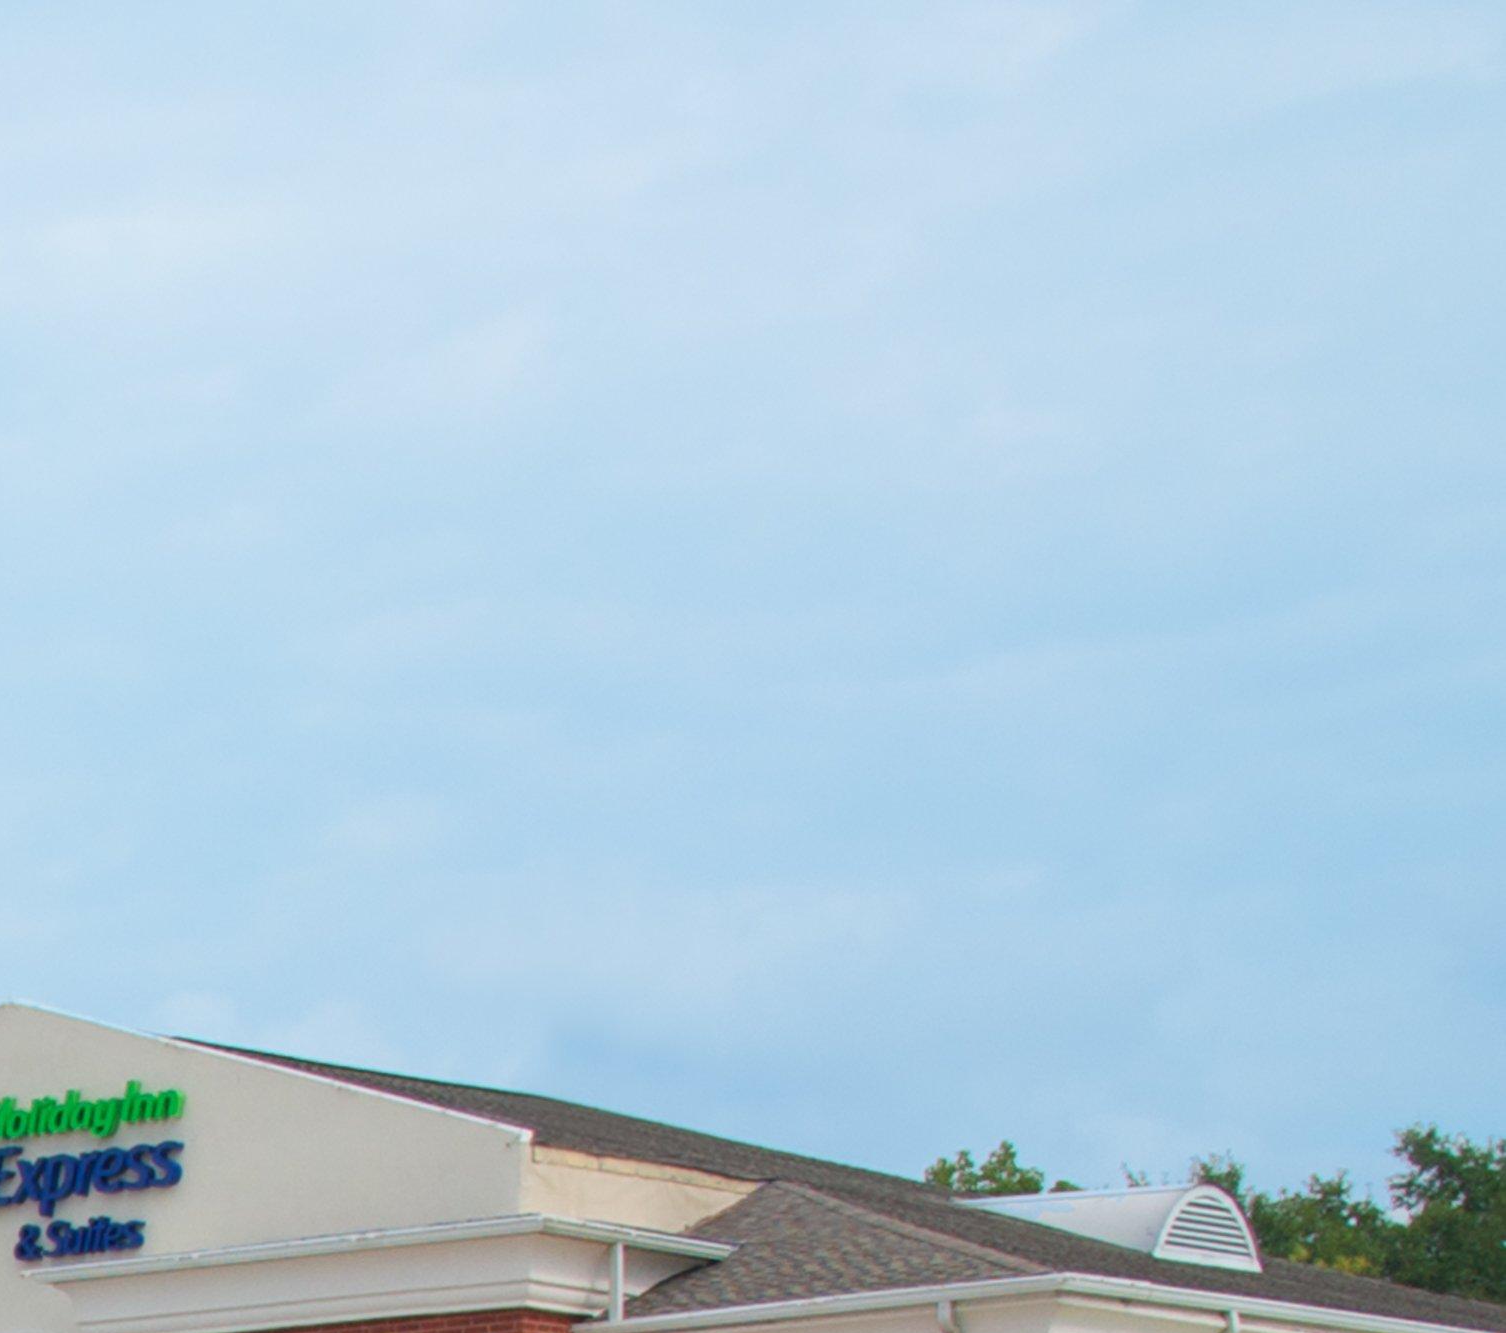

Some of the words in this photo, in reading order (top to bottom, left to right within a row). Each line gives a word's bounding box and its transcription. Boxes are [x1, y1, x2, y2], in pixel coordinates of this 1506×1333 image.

[121, 1078, 185, 1126] Inn
[13, 1223, 44, 1262] &
[43, 1215, 147, 1258] Suites
